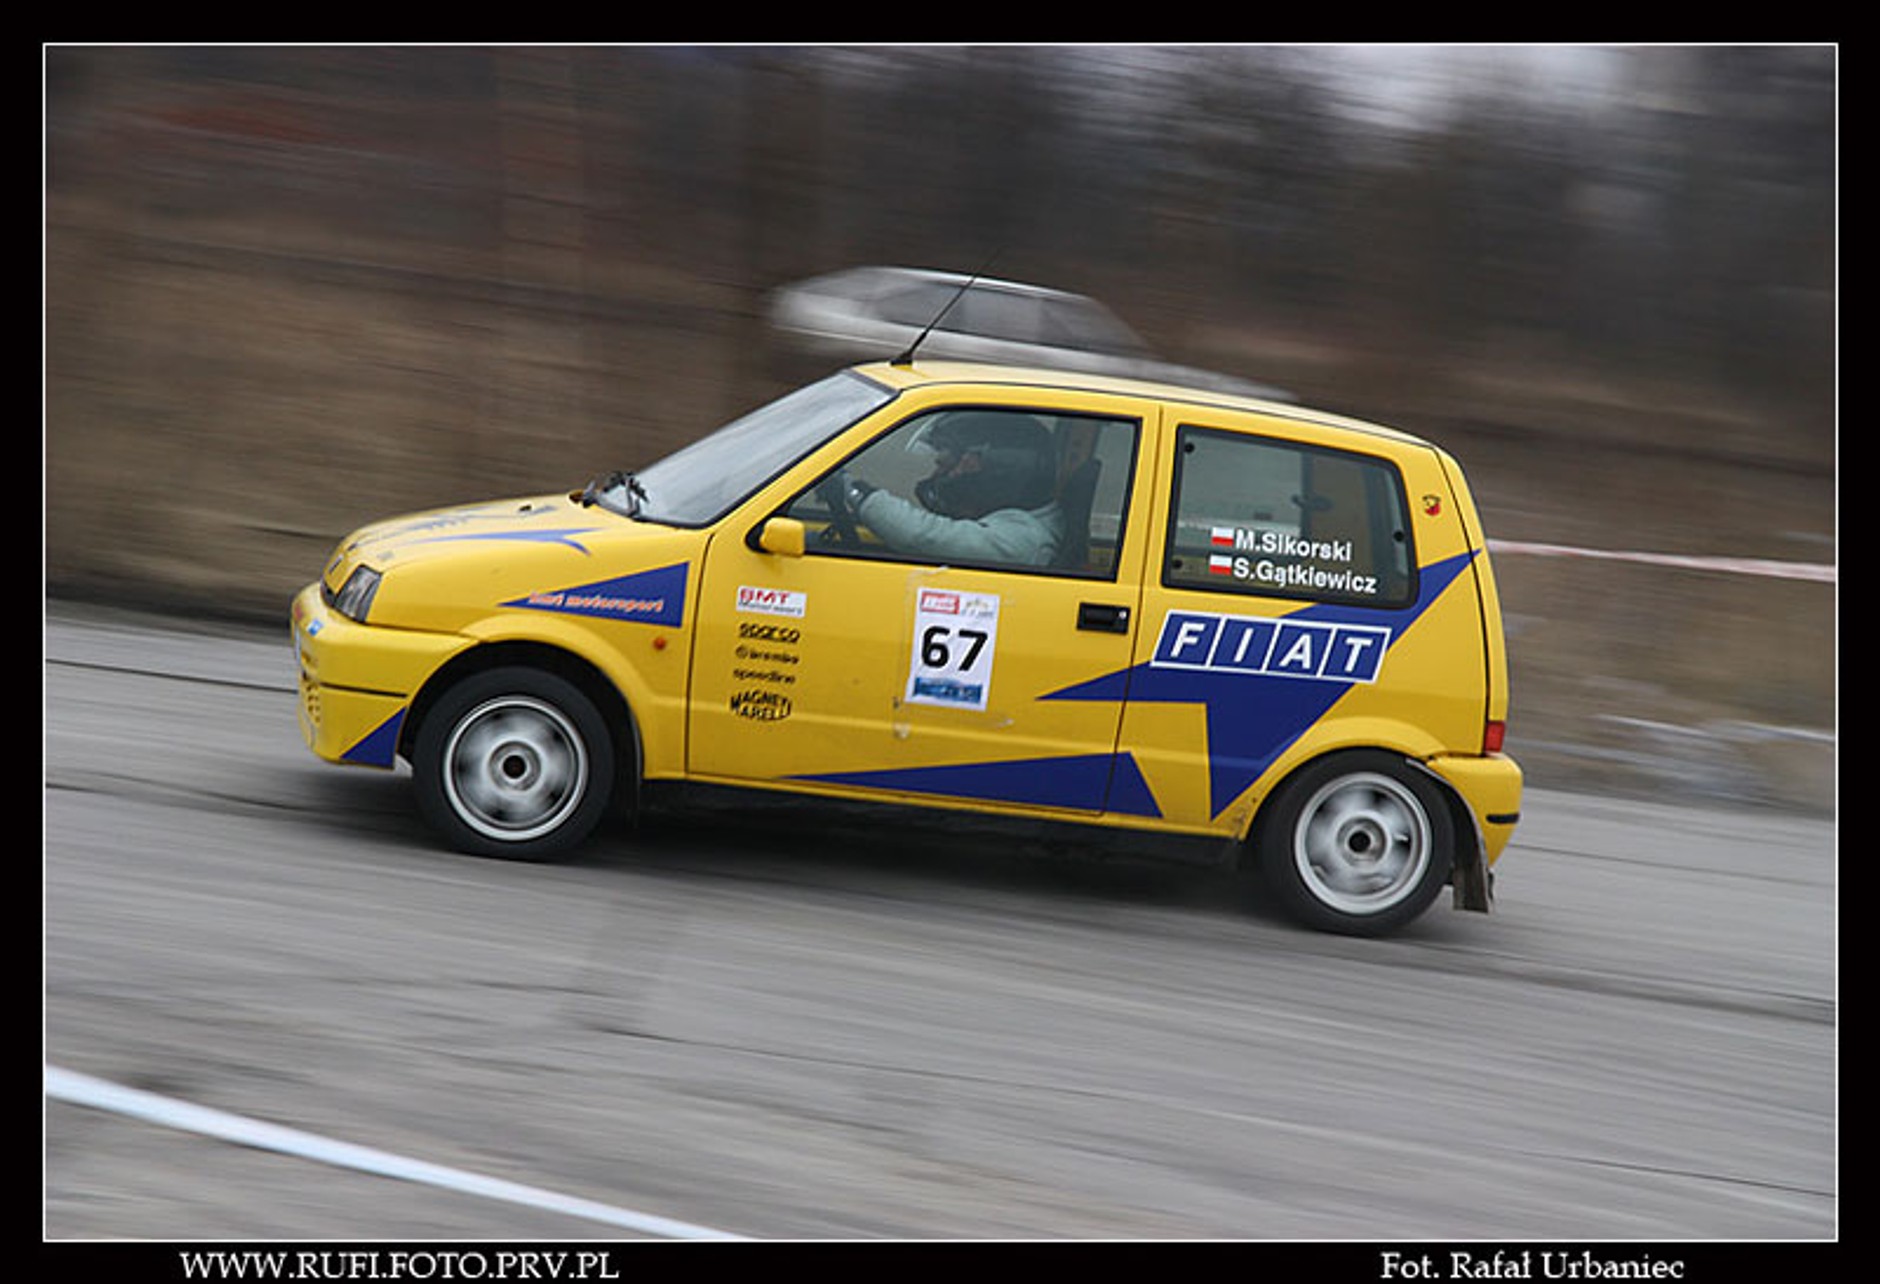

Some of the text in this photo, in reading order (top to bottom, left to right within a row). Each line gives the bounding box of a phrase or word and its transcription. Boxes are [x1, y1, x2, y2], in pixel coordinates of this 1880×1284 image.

[1235, 528, 1352, 562] M.Sikorski
[1233, 557, 1377, 594] S.Gątkiewicz
[921, 625, 988, 672] 67
[1169, 620, 1374, 673] FIAT
